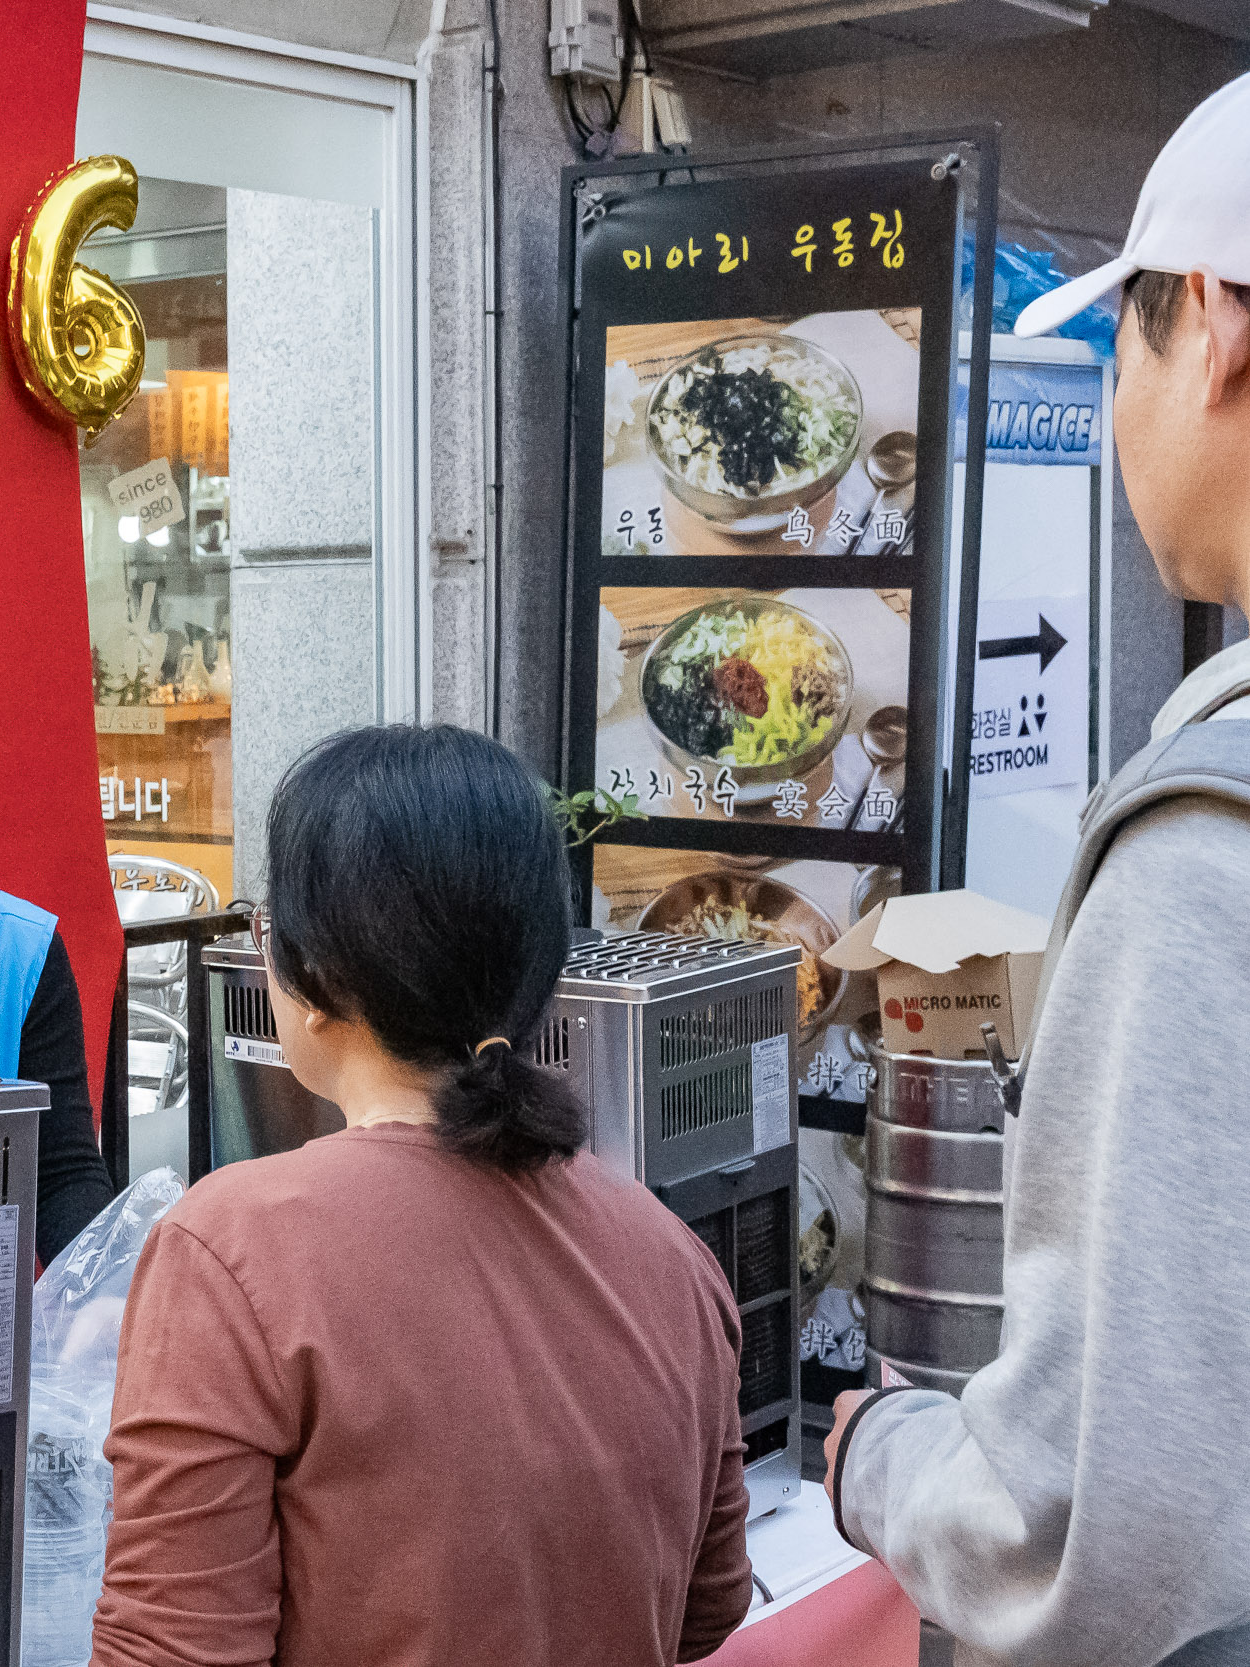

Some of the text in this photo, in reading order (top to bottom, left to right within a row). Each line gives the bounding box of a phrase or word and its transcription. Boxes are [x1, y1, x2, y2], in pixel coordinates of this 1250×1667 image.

[622, 209, 905, 274] 미아리 우동집
[987, 400, 1095, 452] MAGICE
[118, 472, 167, 506] since
[140, 495, 173, 524] 980
[615, 506, 663, 547] 우동
[969, 743, 1048, 775] RESTROOM
[611, 769, 736, 815] 잔치국수
[904, 993, 1000, 1011] MICRO MATIC
